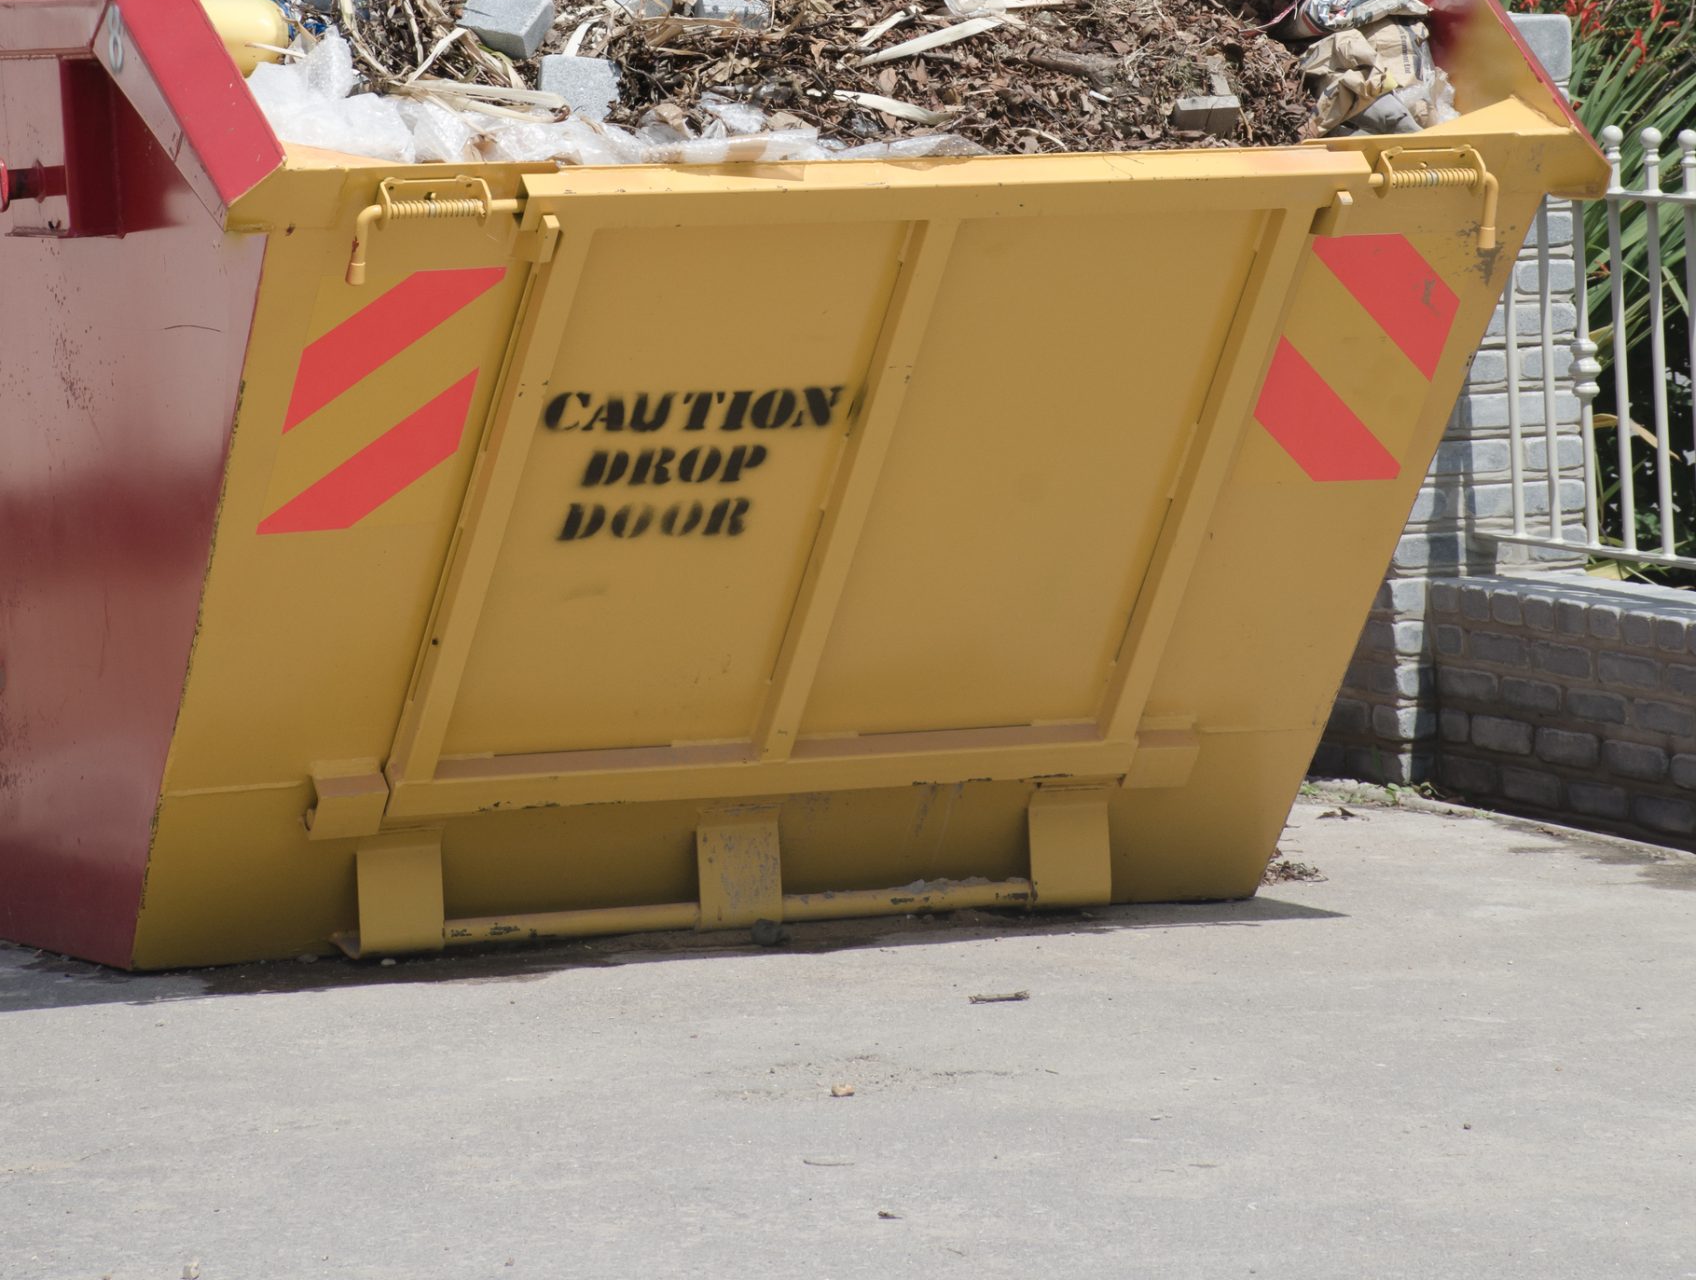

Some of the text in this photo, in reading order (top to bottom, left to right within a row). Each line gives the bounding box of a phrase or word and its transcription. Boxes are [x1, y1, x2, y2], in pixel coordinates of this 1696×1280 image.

[544, 386, 846, 432] CAUTION
[581, 444, 768, 487] DROP
[556, 497, 751, 541] DOOR
